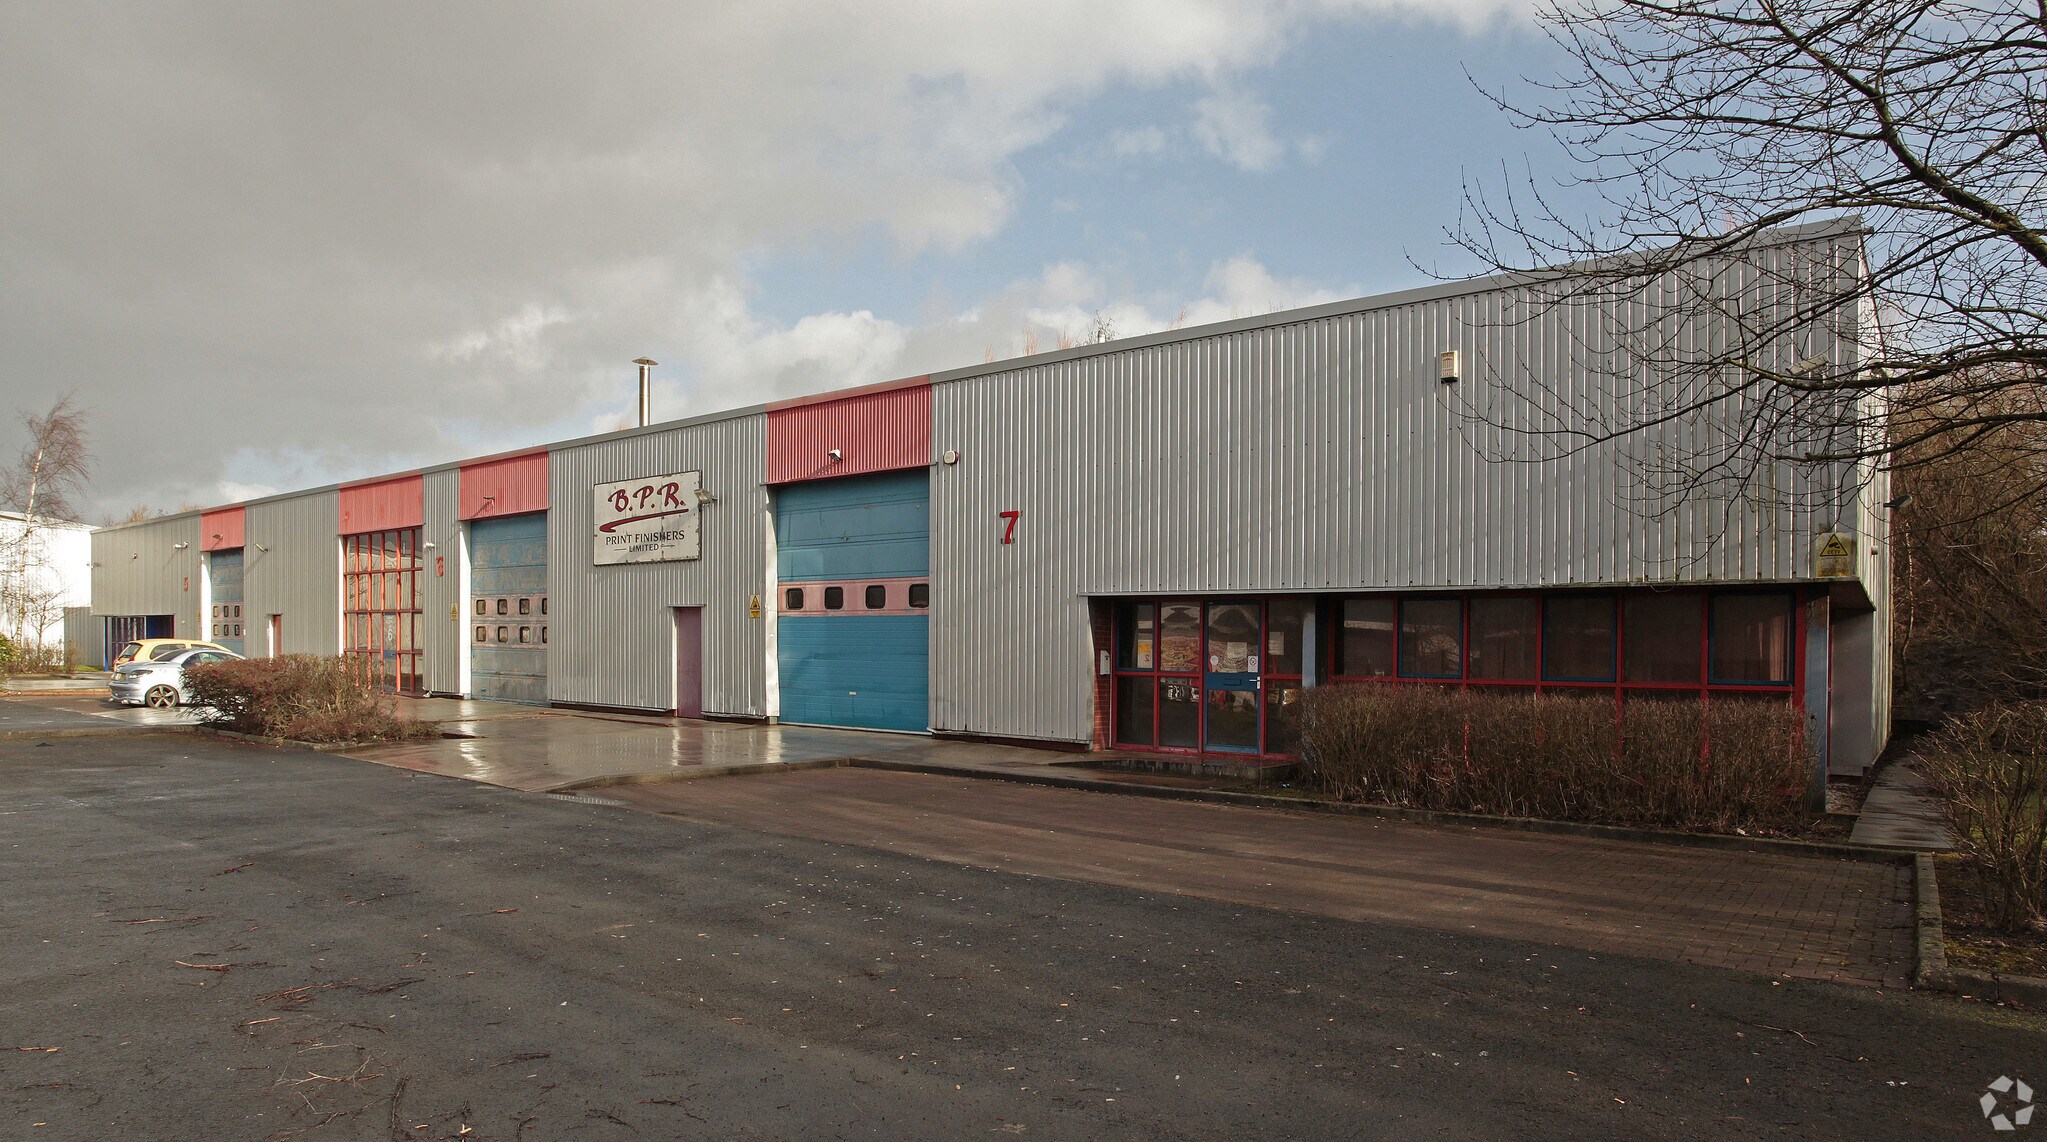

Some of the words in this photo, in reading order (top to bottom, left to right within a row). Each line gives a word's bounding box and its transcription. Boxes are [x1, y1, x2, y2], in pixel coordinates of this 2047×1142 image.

[608, 482, 686, 512] B.P.R.
[999, 510, 1019, 545] 7
[605, 534, 632, 546] PRINT
[635, 530, 685, 543] FINISHERS
[629, 543, 659, 553] LIMITED
[436, 555, 445, 577] 6
[387, 628, 394, 641] 6
